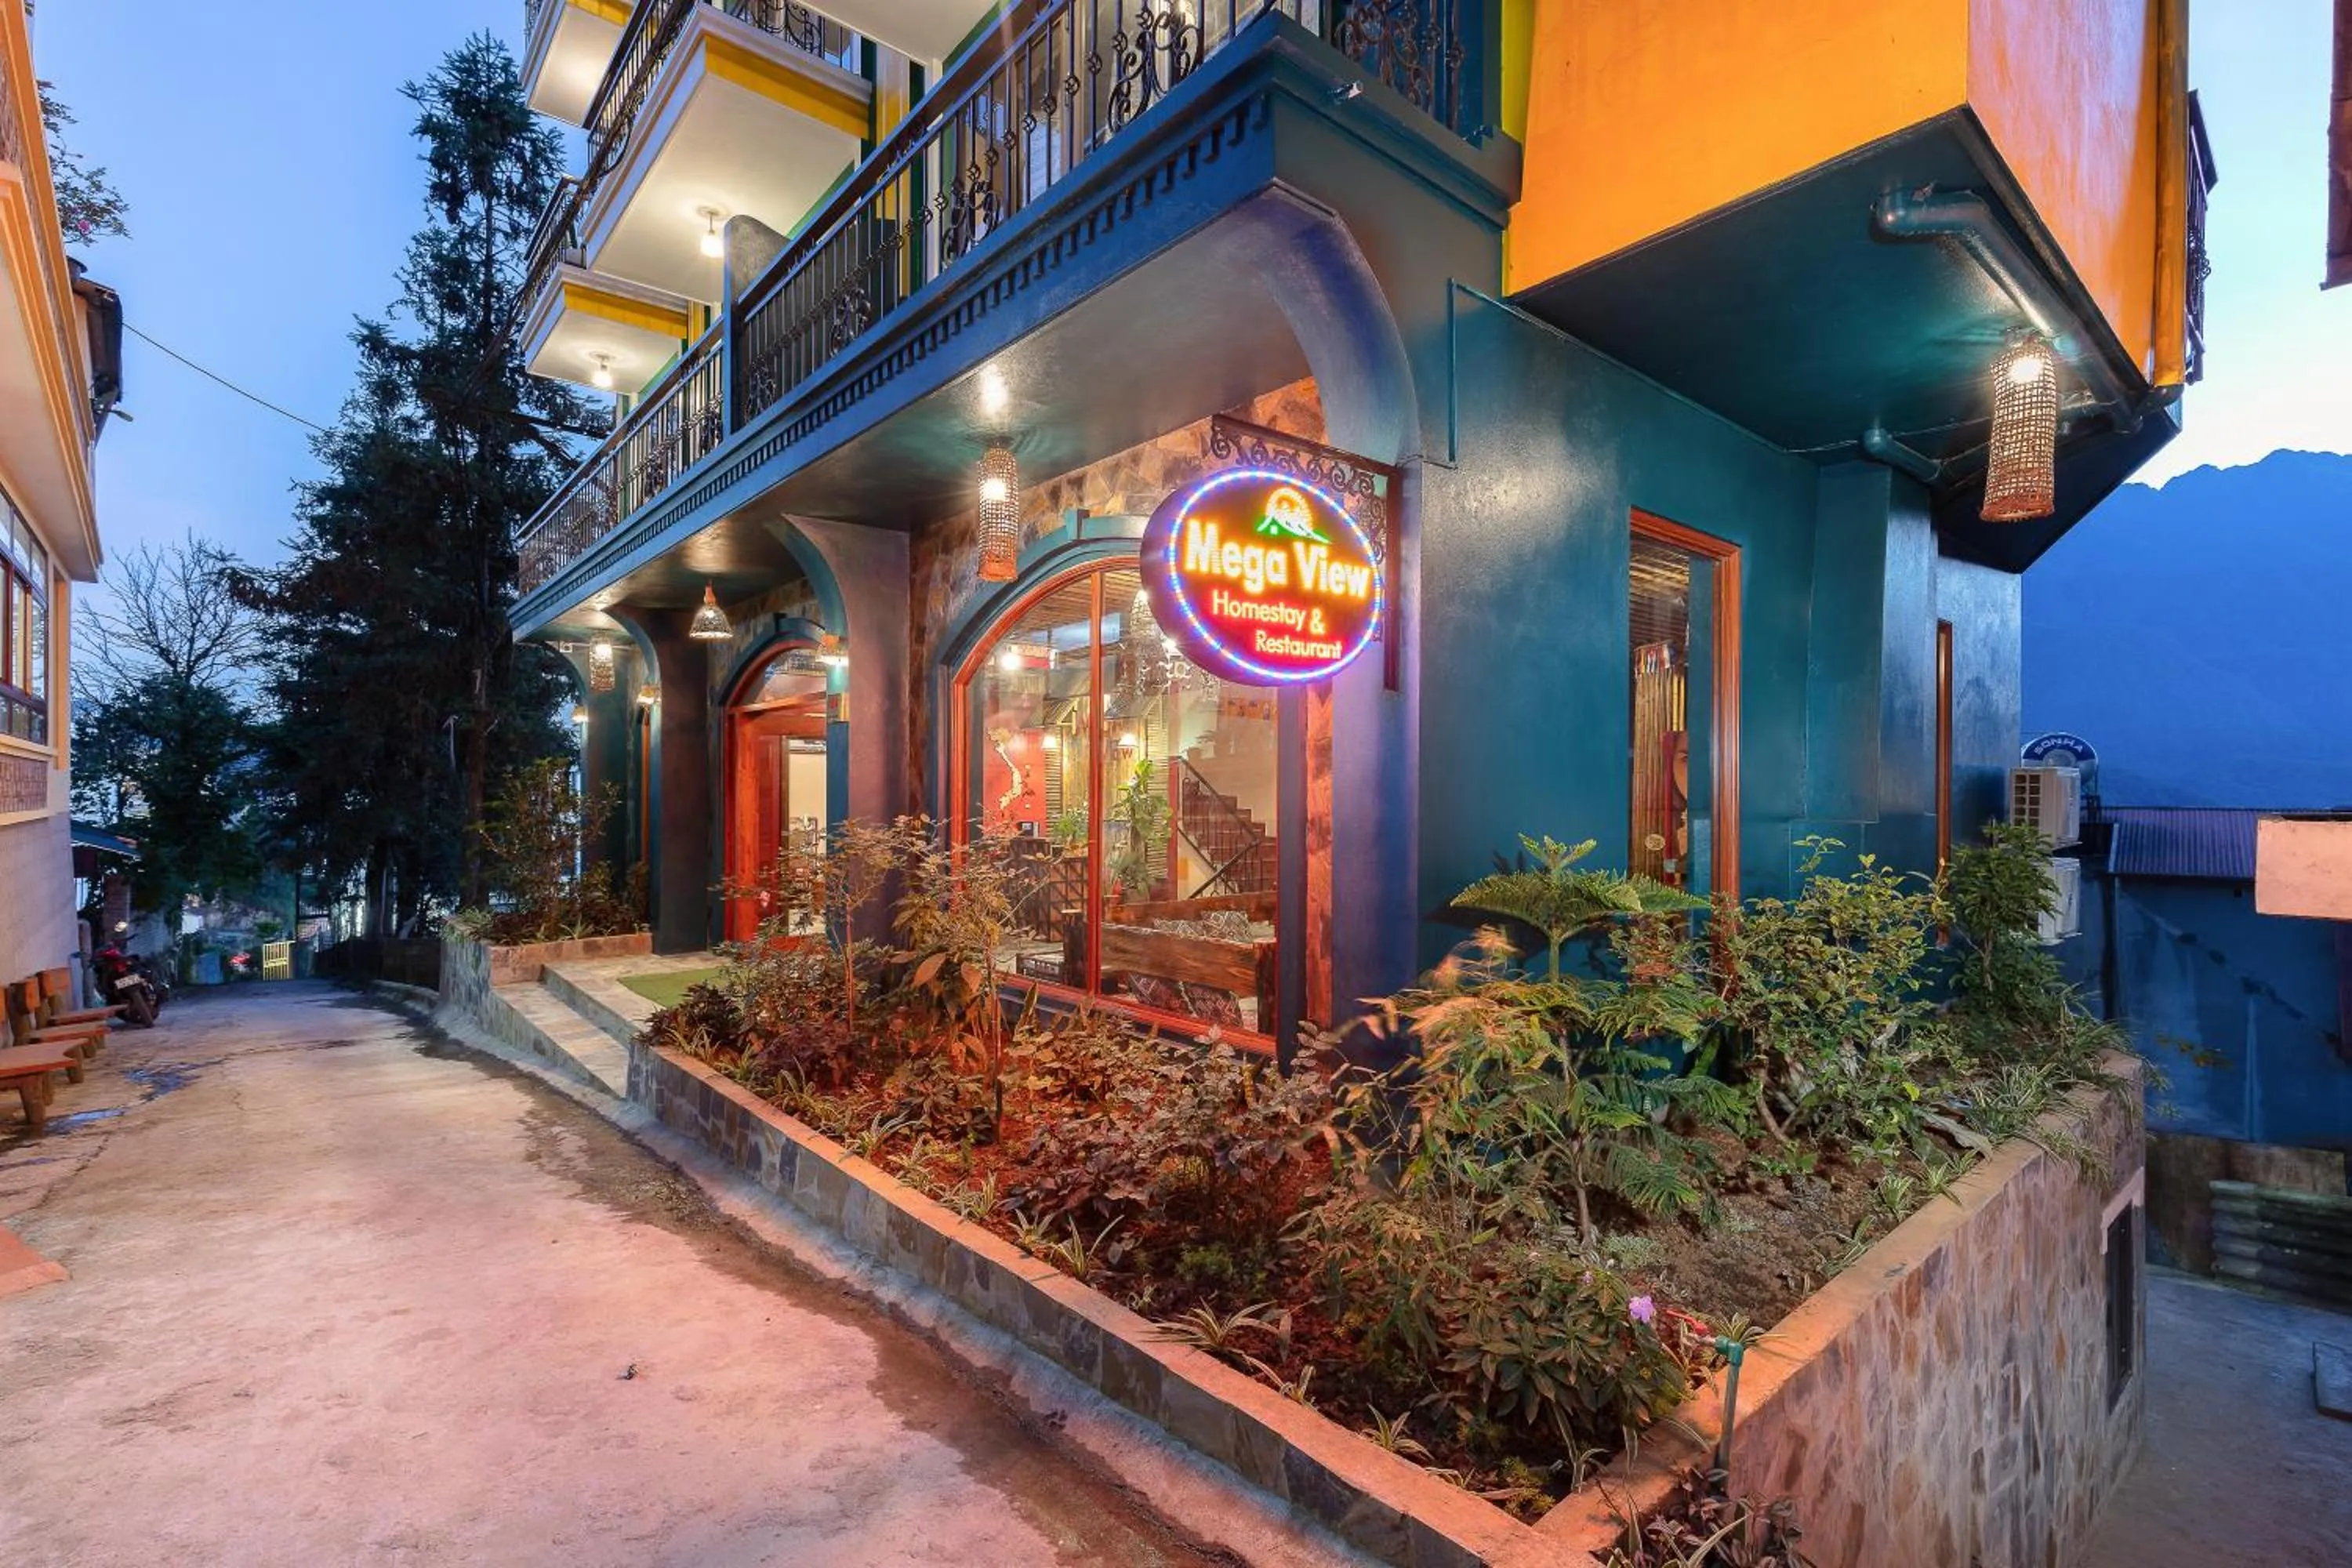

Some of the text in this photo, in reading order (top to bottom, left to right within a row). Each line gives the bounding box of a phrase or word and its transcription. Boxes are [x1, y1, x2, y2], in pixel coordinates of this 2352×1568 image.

[1186, 519, 1370, 598] Mega View
[1212, 590, 1325, 634] Homestay &
[1256, 630, 1342, 659] Restaurant
[2034, 738, 2083, 755] SONHA
